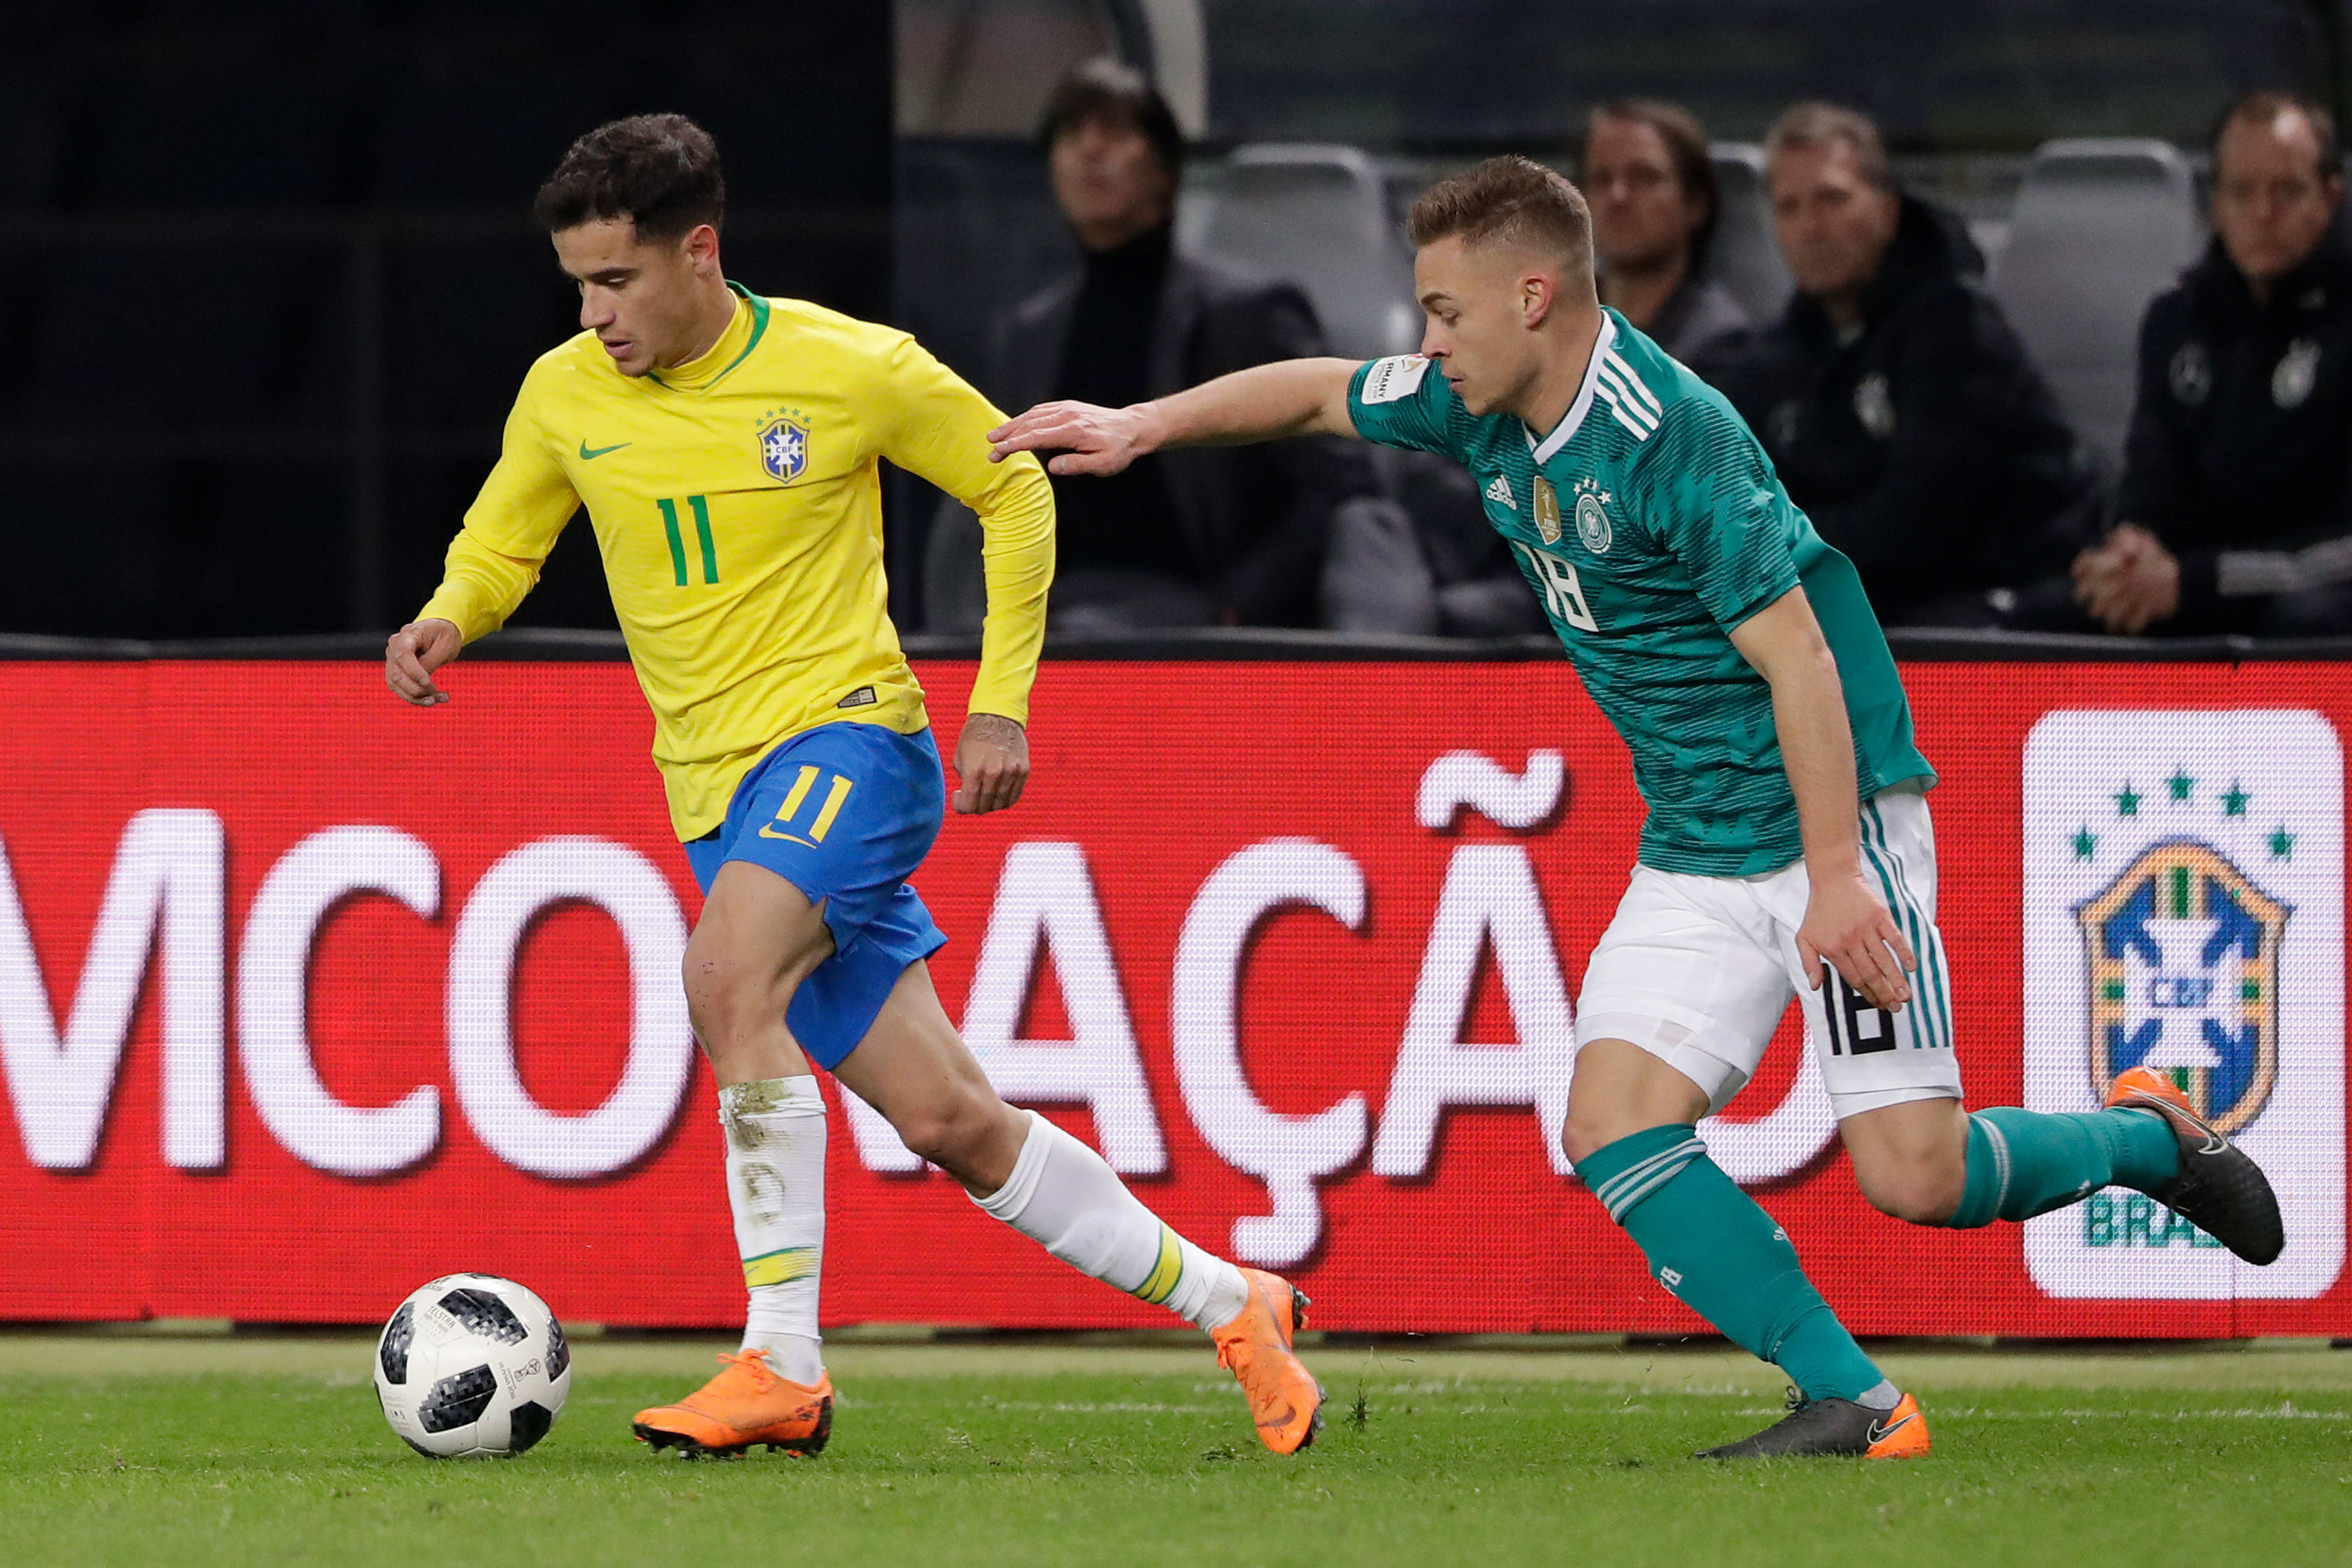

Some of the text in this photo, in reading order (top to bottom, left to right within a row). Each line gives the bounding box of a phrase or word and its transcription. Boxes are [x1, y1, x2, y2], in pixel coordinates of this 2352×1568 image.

[657, 494, 719, 587] 11
[1513, 540, 1600, 633] 18
[774, 765, 854, 844] 11
[2084, 1191, 2225, 1248] BRA
[427, 1306, 456, 1329] TELSTAR
